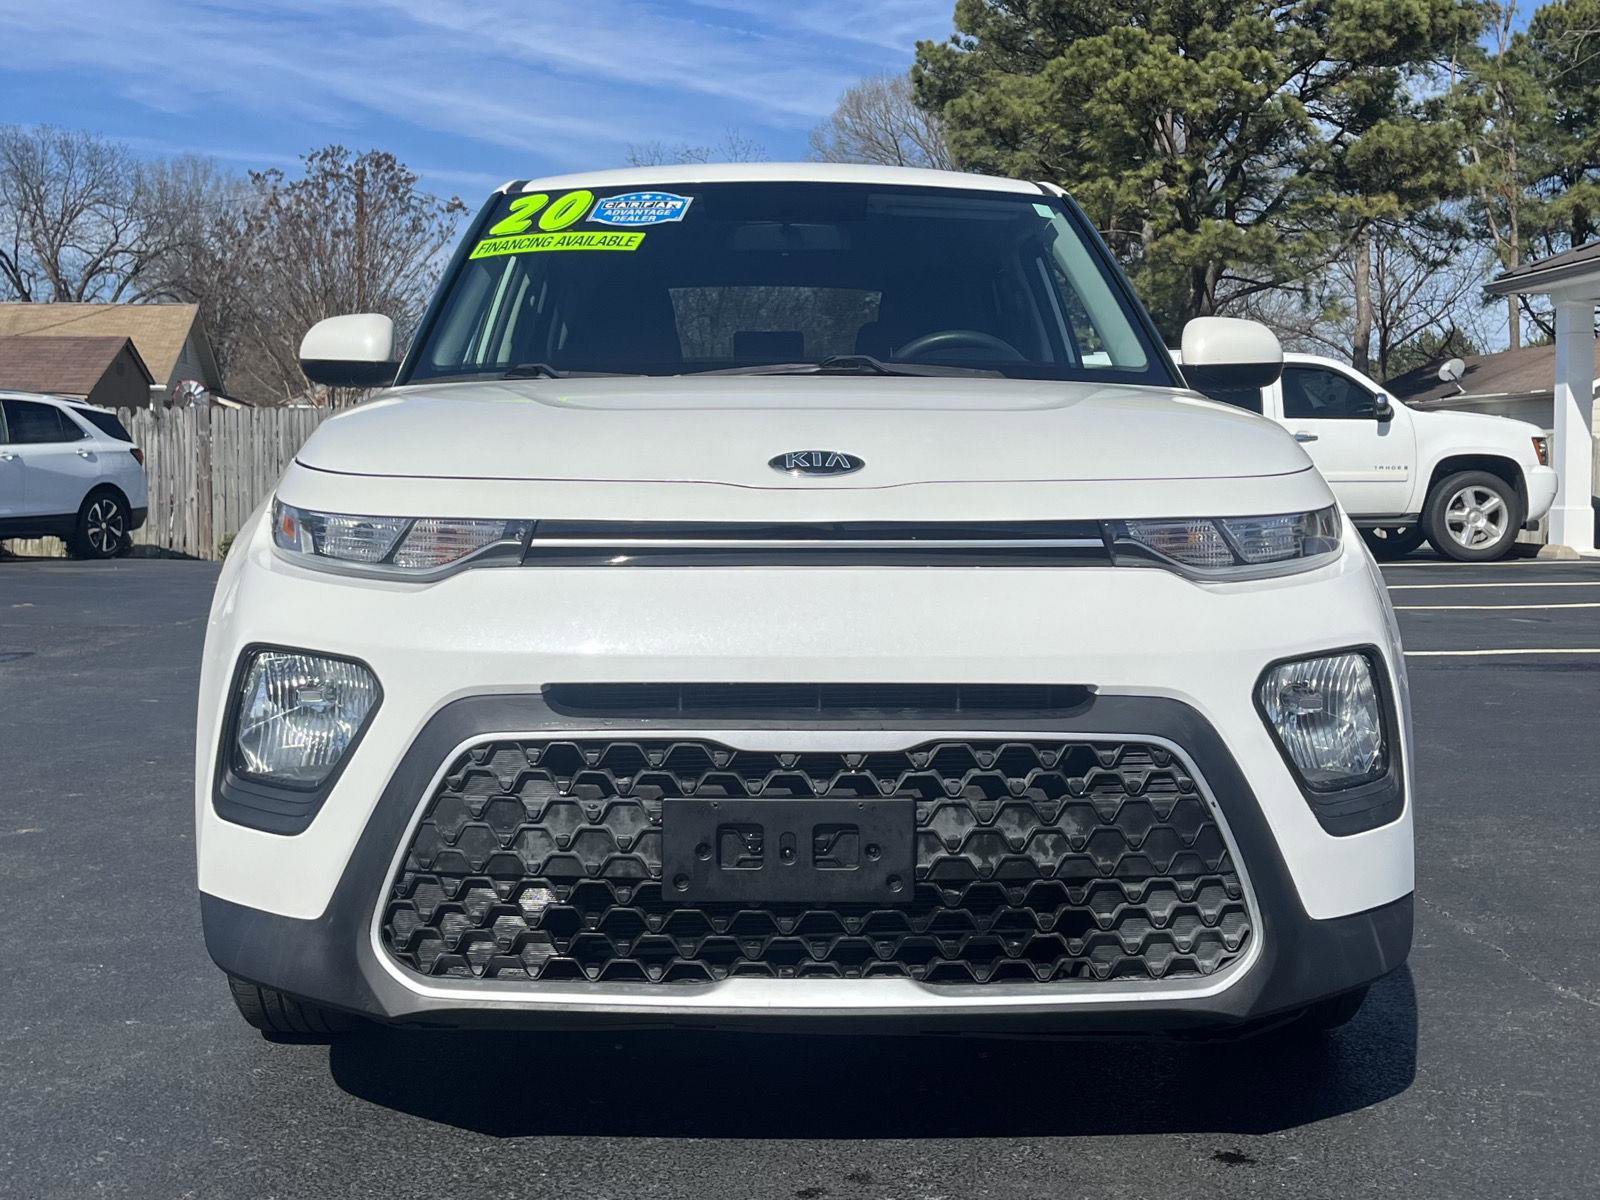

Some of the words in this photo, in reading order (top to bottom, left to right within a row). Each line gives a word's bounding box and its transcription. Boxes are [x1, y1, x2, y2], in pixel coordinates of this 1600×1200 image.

[489, 190, 594, 235] 20
[478, 236, 553, 253] FINANCING
[555, 235, 638, 248] AVAILABLE
[785, 452, 851, 468] KIA
